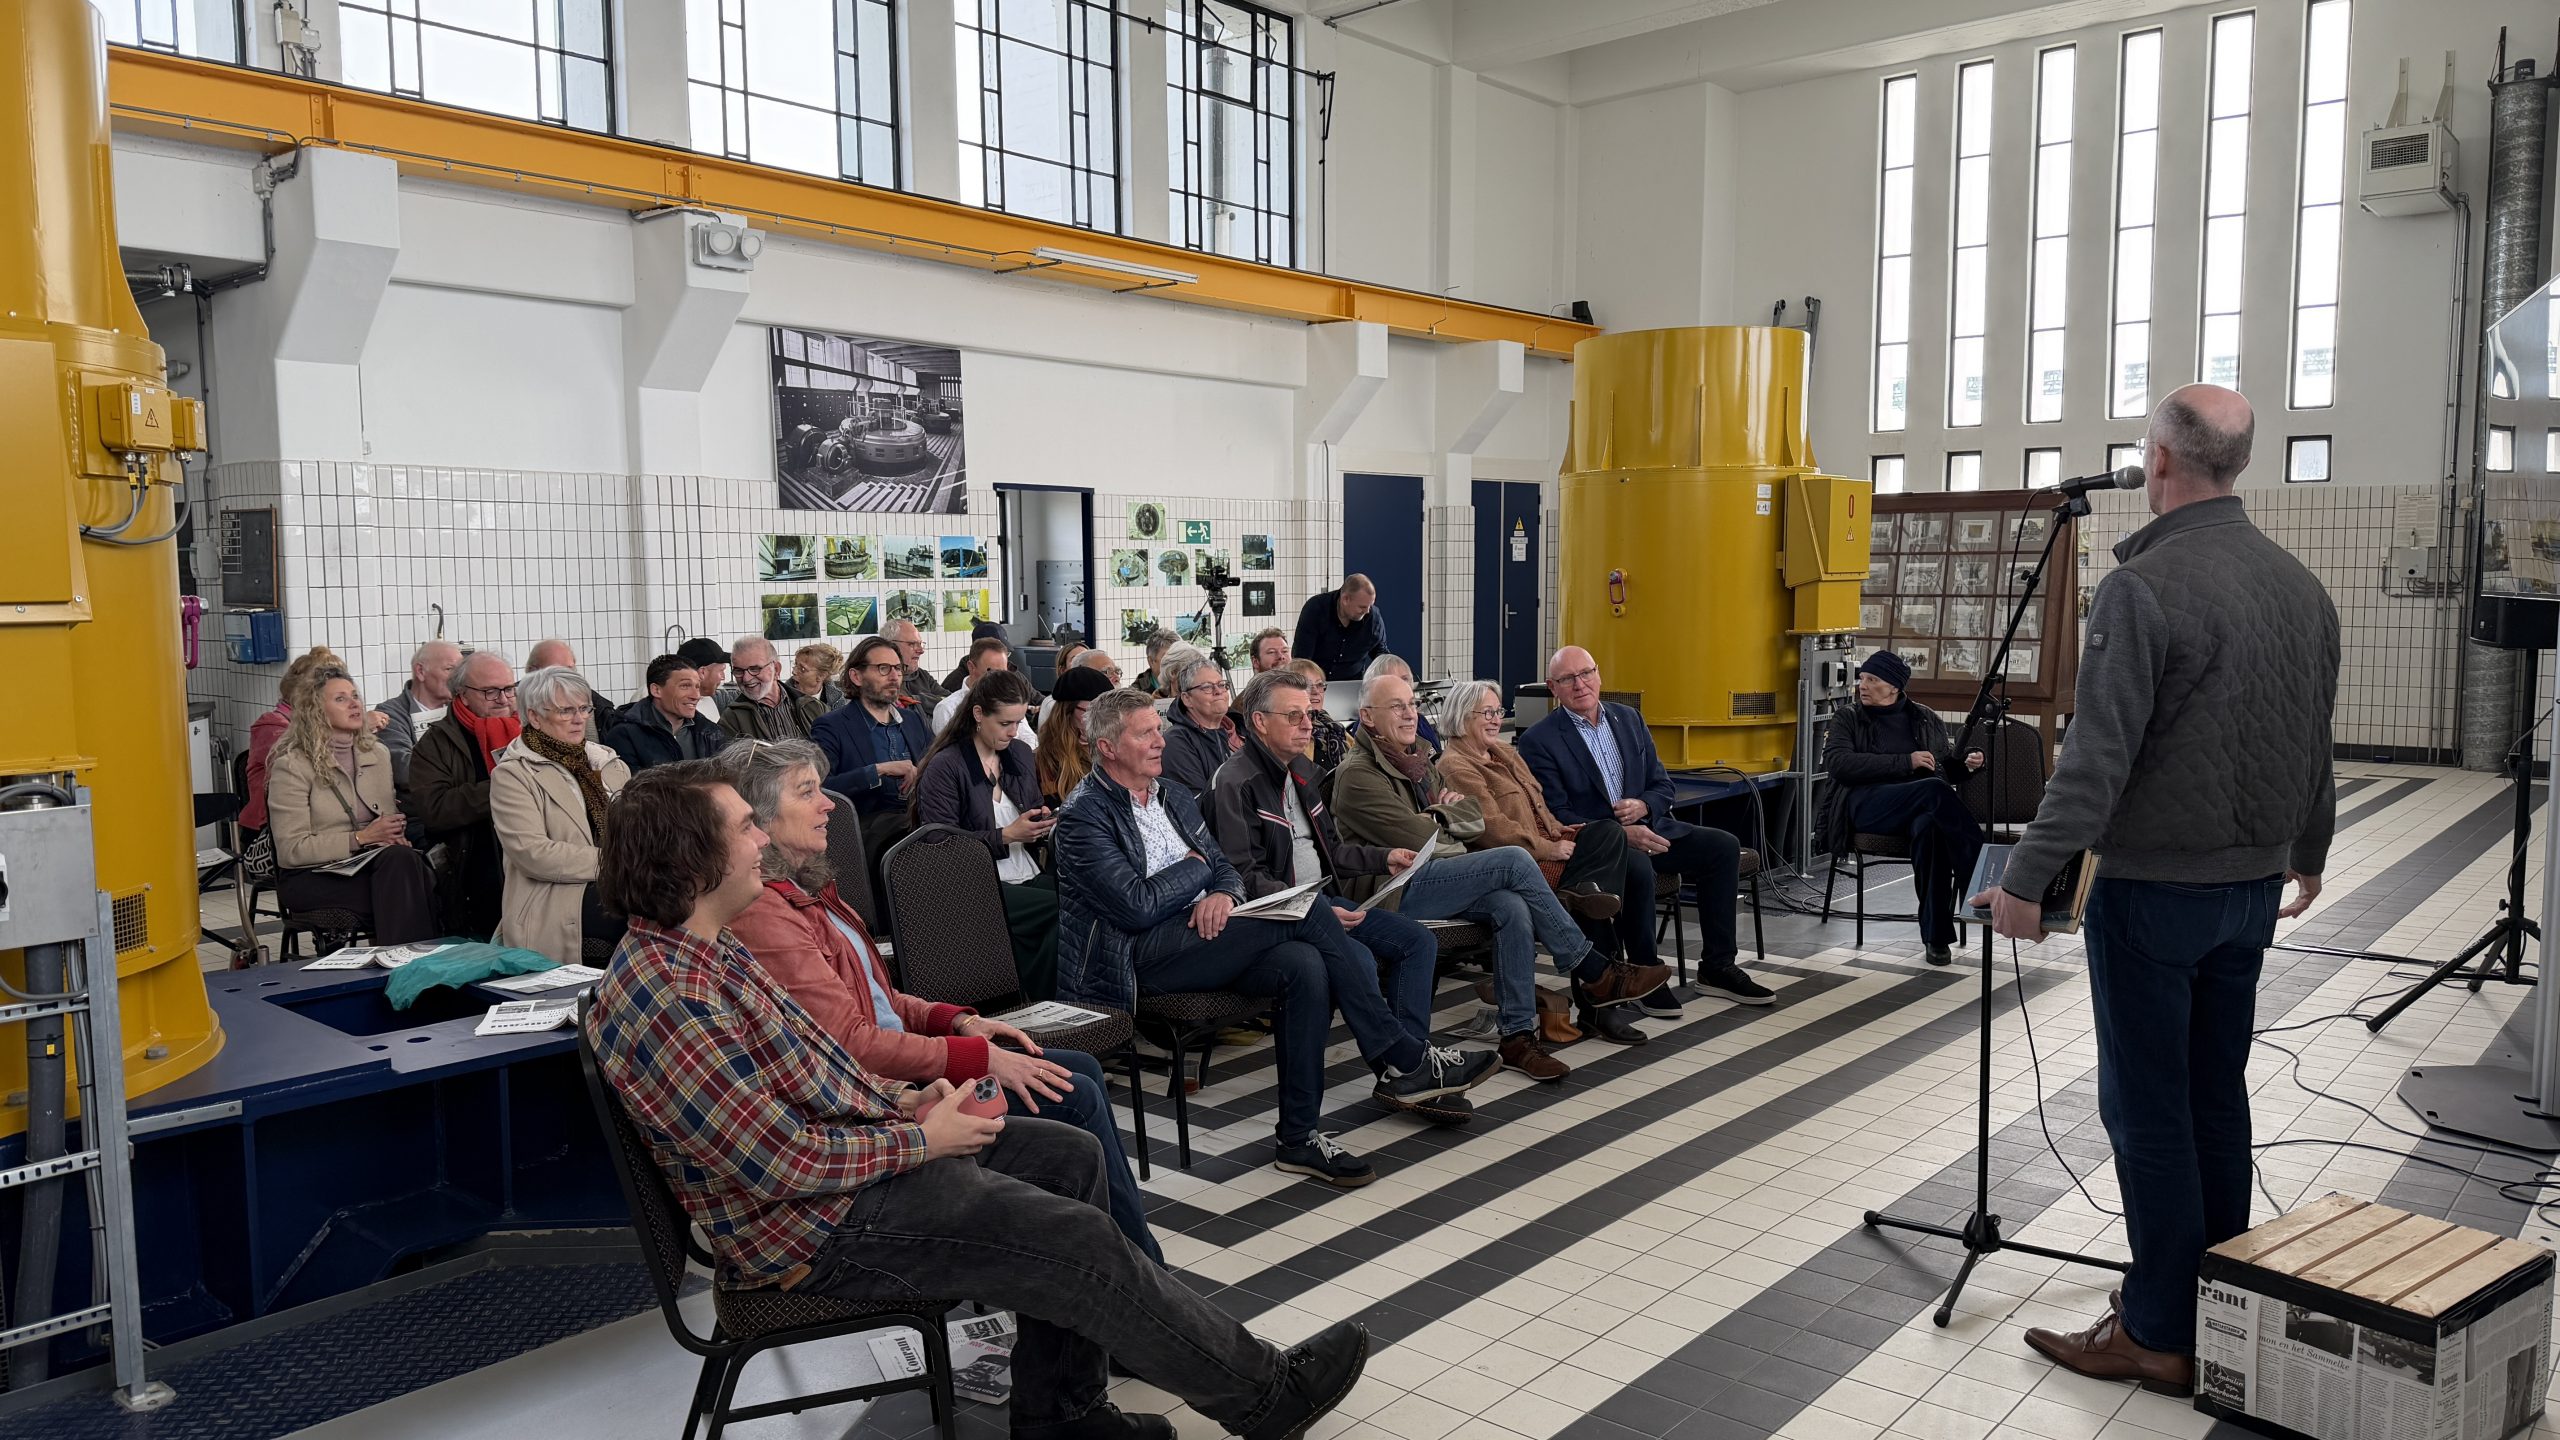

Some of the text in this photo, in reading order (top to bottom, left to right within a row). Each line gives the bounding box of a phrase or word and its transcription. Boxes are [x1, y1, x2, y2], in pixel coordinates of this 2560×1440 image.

[894, 1336, 922, 1373] Courant
[2279, 1340, 2290, 1350] en
[2291, 1343, 2305, 1354] het
